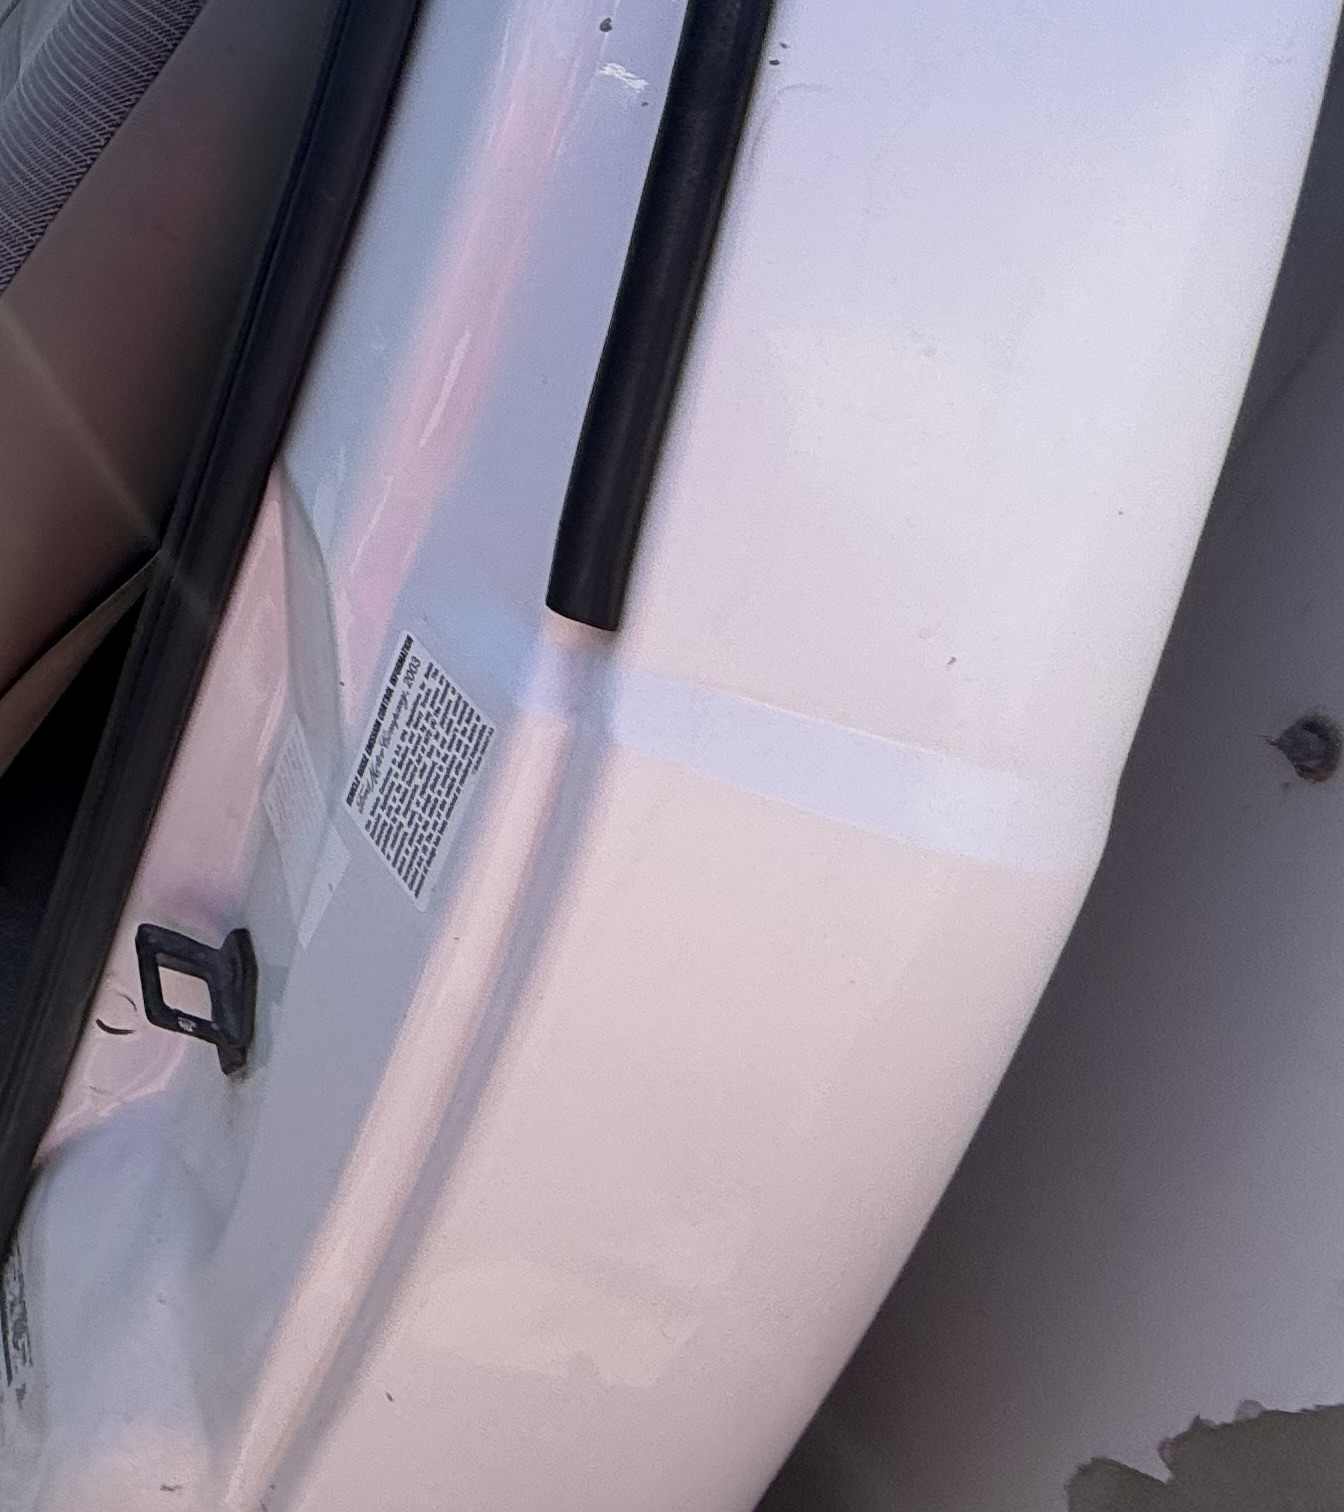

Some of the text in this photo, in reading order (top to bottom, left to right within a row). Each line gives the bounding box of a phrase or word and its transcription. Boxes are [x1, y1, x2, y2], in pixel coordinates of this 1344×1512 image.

[345, 774, 360, 808] VEHICLE
[376, 683, 394, 722] CONTROL
[388, 632, 413, 689] INFORMATION
[401, 652, 421, 691] 2003
